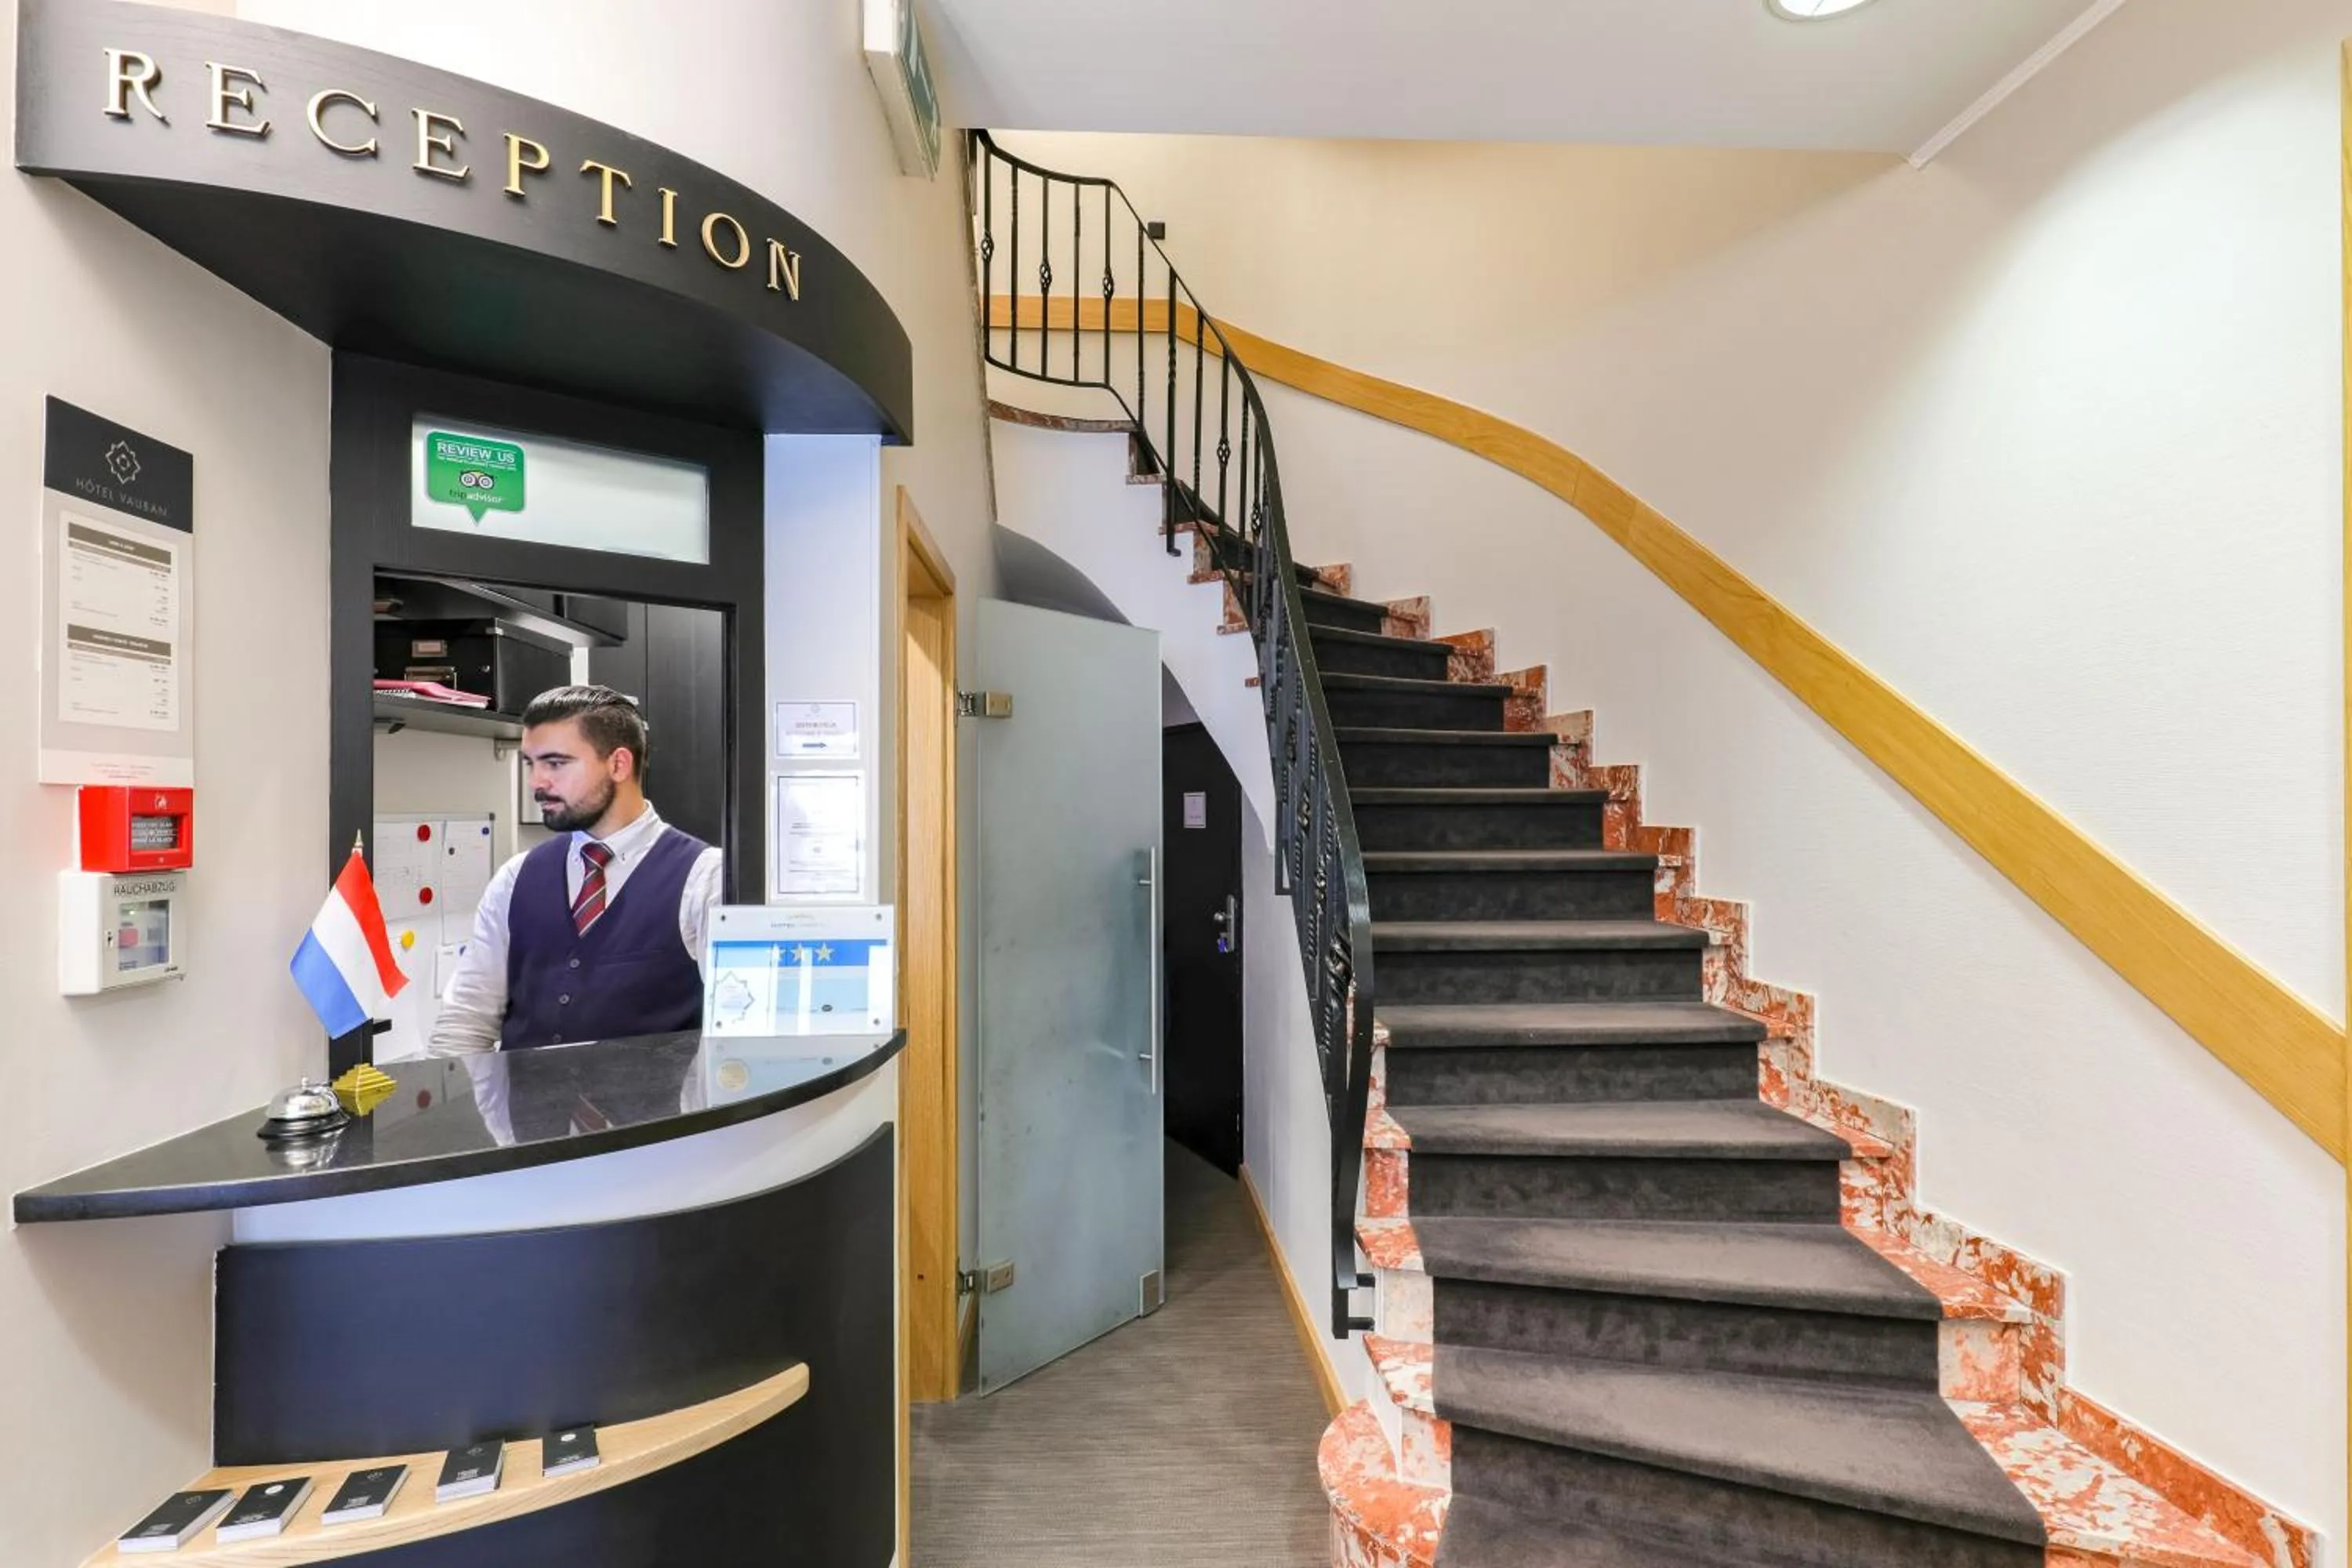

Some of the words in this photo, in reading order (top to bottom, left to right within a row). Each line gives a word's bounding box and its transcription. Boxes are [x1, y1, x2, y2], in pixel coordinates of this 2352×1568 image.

[103, 47, 802, 301] RECEPTION
[437, 441, 492, 459] REVIEW
[497, 451, 516, 463] US
[76, 477, 114, 501] HÔTEL
[119, 492, 168, 516] VAUBAN
[449, 488, 503, 503] tripadvisor
[113, 880, 176, 896] RAUCHABZUG
